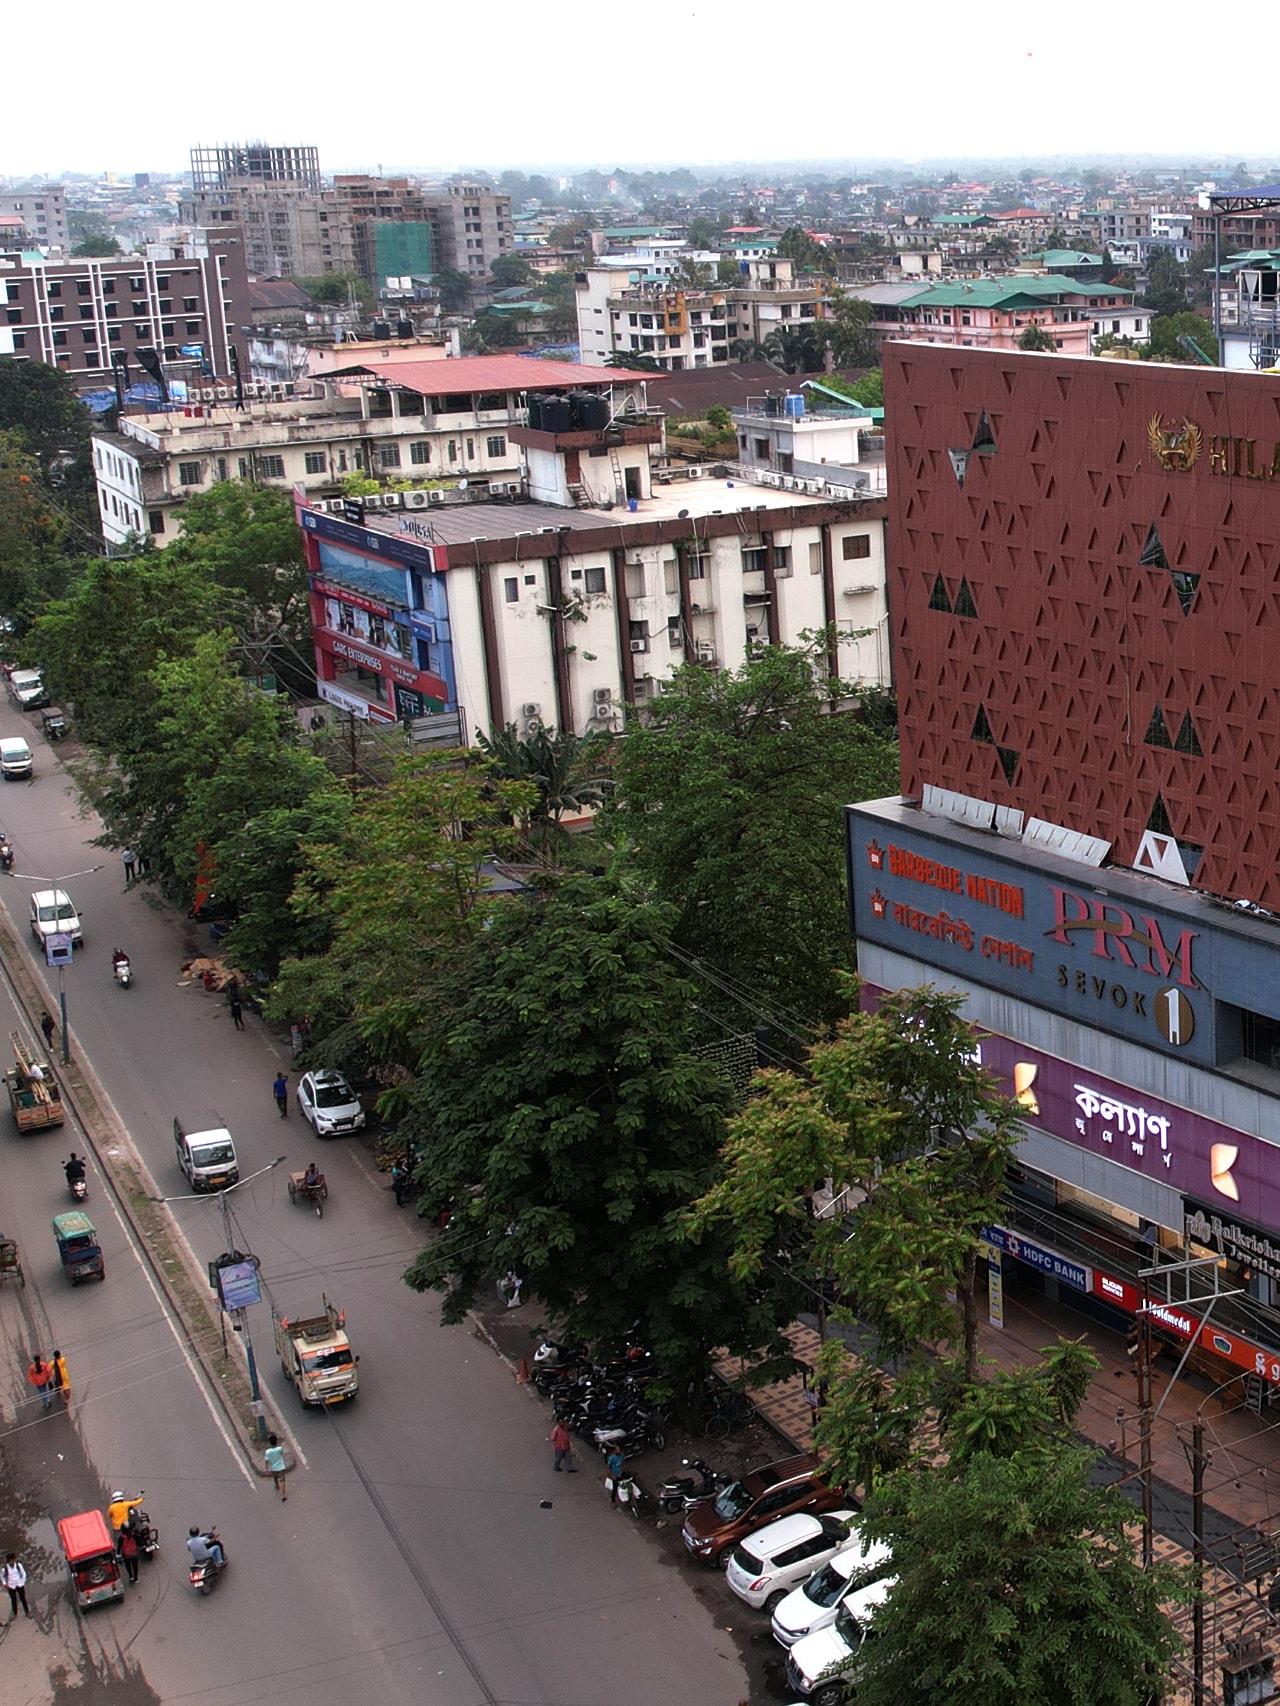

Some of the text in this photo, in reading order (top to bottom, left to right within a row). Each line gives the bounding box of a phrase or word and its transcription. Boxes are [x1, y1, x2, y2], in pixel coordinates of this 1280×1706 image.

[888, 843, 1025, 920] BARBEQUE NATION
[1048, 886, 1200, 990] PRM
[1057, 964, 1147, 1018] SEVOK
[1073, 1084, 1171, 1150] কল্যাণ
[1023, 1246, 1085, 1285] HDFC BANK
